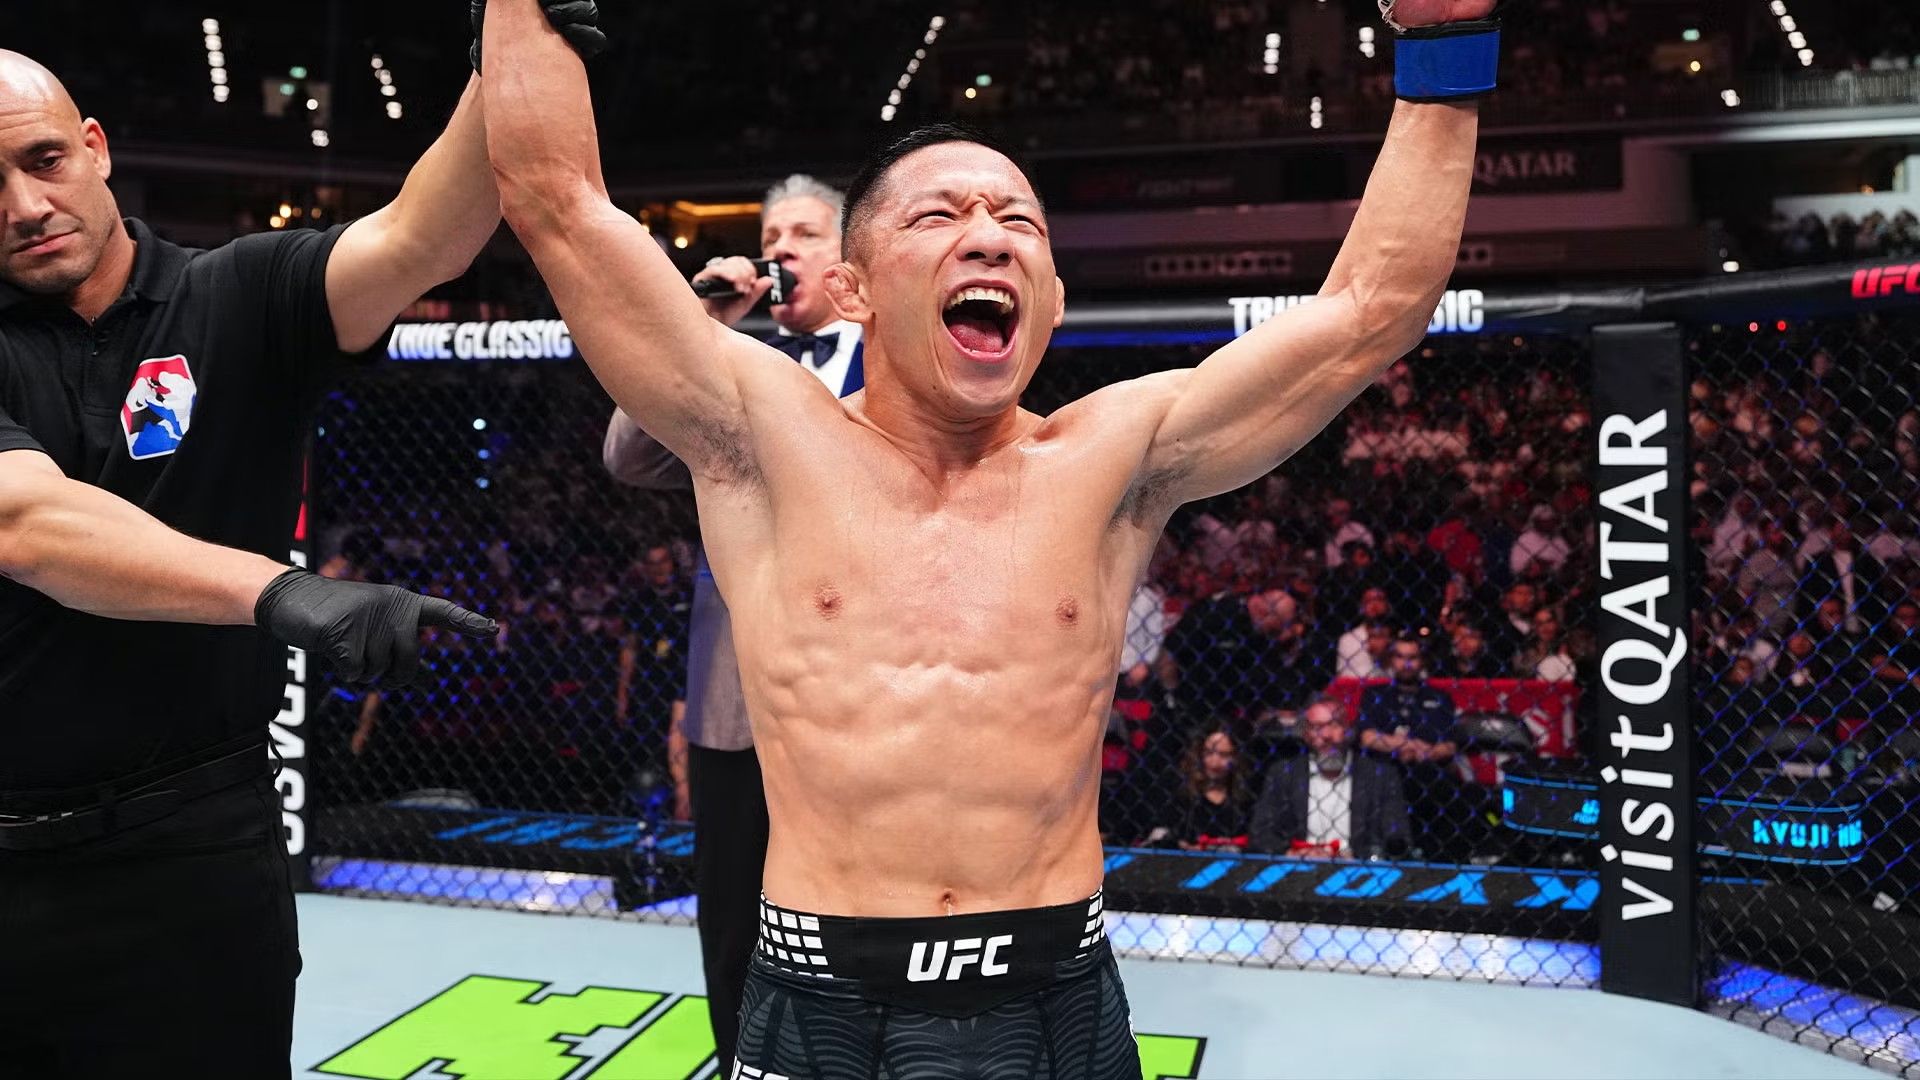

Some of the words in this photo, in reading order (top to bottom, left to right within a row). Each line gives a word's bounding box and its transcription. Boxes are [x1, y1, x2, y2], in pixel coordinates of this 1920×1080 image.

[1473, 152, 1577, 185] QATAR
[454, 319, 573, 360] CLASSIC
[906, 934, 1013, 982] UFC
